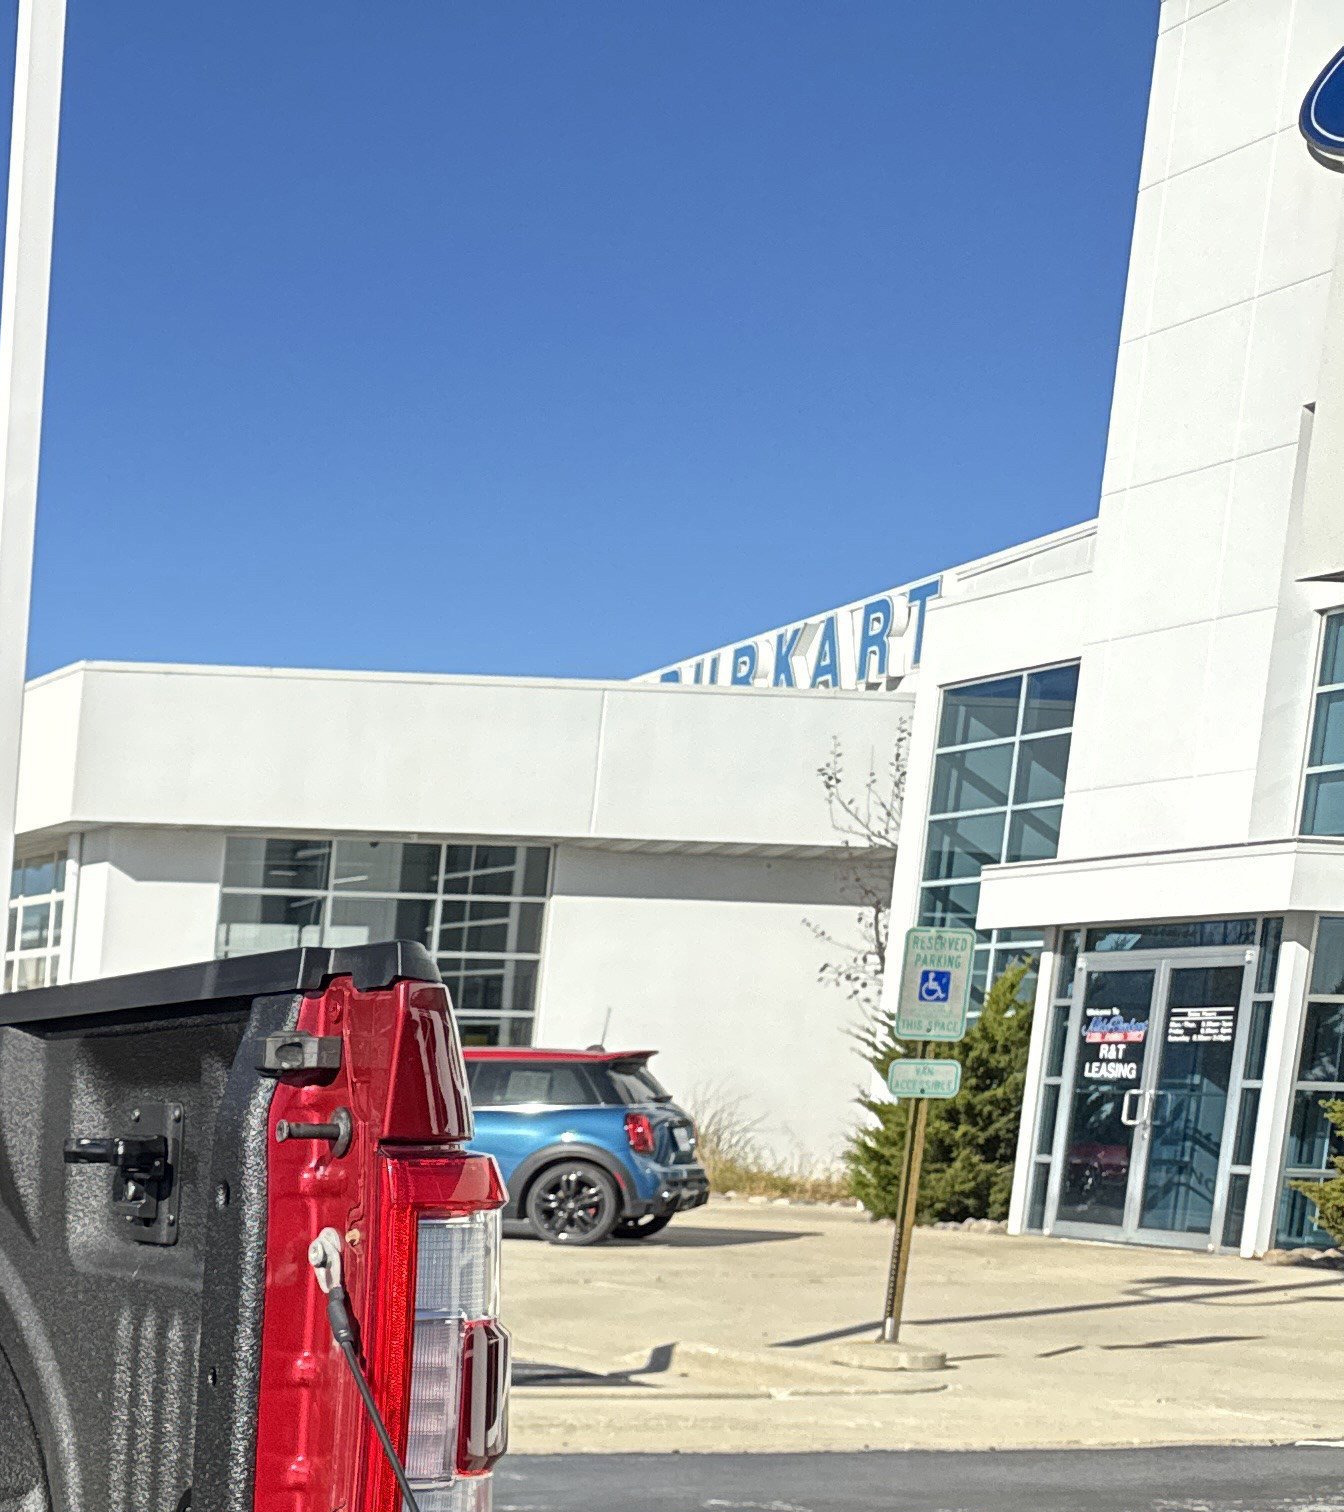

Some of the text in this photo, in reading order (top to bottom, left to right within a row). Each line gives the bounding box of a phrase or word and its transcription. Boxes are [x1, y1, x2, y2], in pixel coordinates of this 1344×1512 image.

[659, 573, 943, 693] URKART
[912, 935, 968, 952] RESERVED
[914, 953, 962, 969] PARKING
[927, 1020, 960, 1033] SPACE
[1099, 1043, 1127, 1060] R&T
[1084, 1062, 1137, 1079] LEASING
